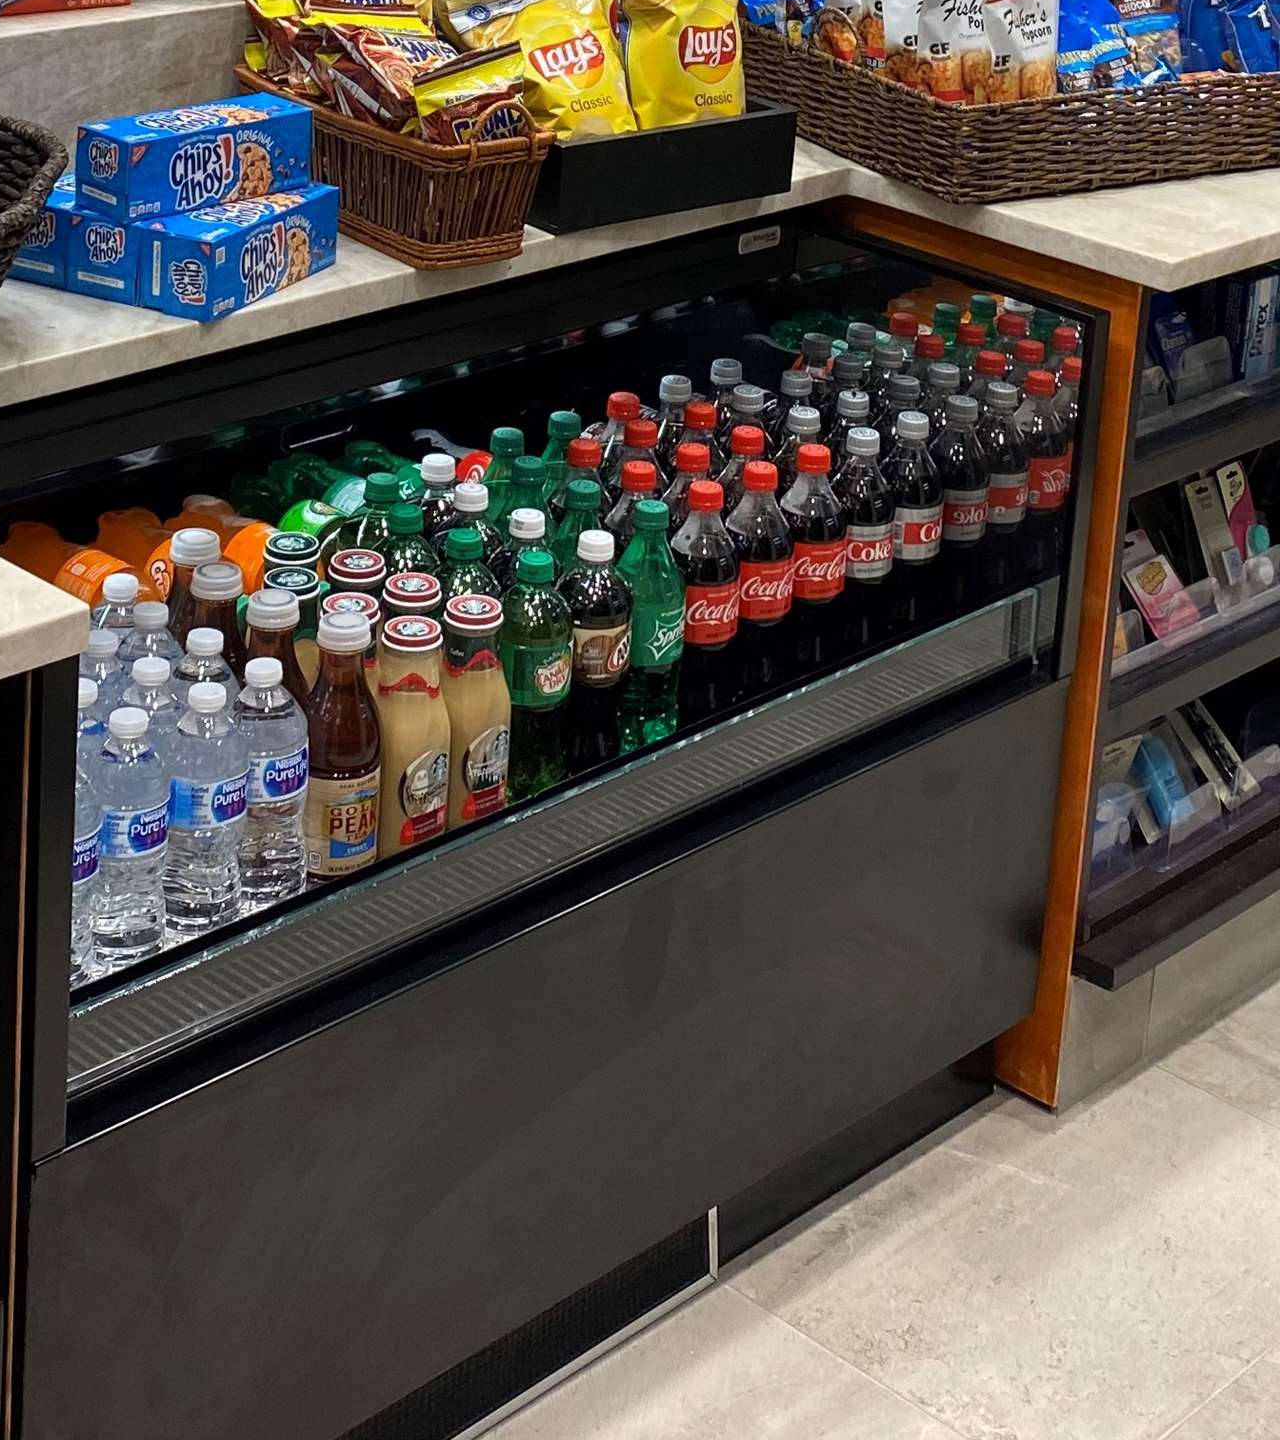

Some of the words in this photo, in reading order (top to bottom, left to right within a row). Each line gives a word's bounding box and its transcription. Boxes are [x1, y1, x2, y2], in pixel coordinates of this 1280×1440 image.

[1020, 25, 1053, 43] Popcorn
[533, 34, 603, 78] Lay's
[683, 26, 735, 67] Lay's
[929, 41, 951, 56] GF
[569, 94, 614, 114] Classic
[694, 91, 734, 108] Classic
[236, 130, 275, 150] ORIGINAL
[89, 141, 117, 166] Chips
[171, 140, 223, 186] Chips
[285, 216, 314, 234] ORIGINAL
[87, 226, 118, 248] Chips
[242, 232, 277, 283] Chips
[183, 260, 203, 297] Chips
[846, 541, 892, 562] Coke
[265, 763, 294, 783] Pure
[214, 788, 241, 808] Pure
[130, 822, 157, 838] Pure
